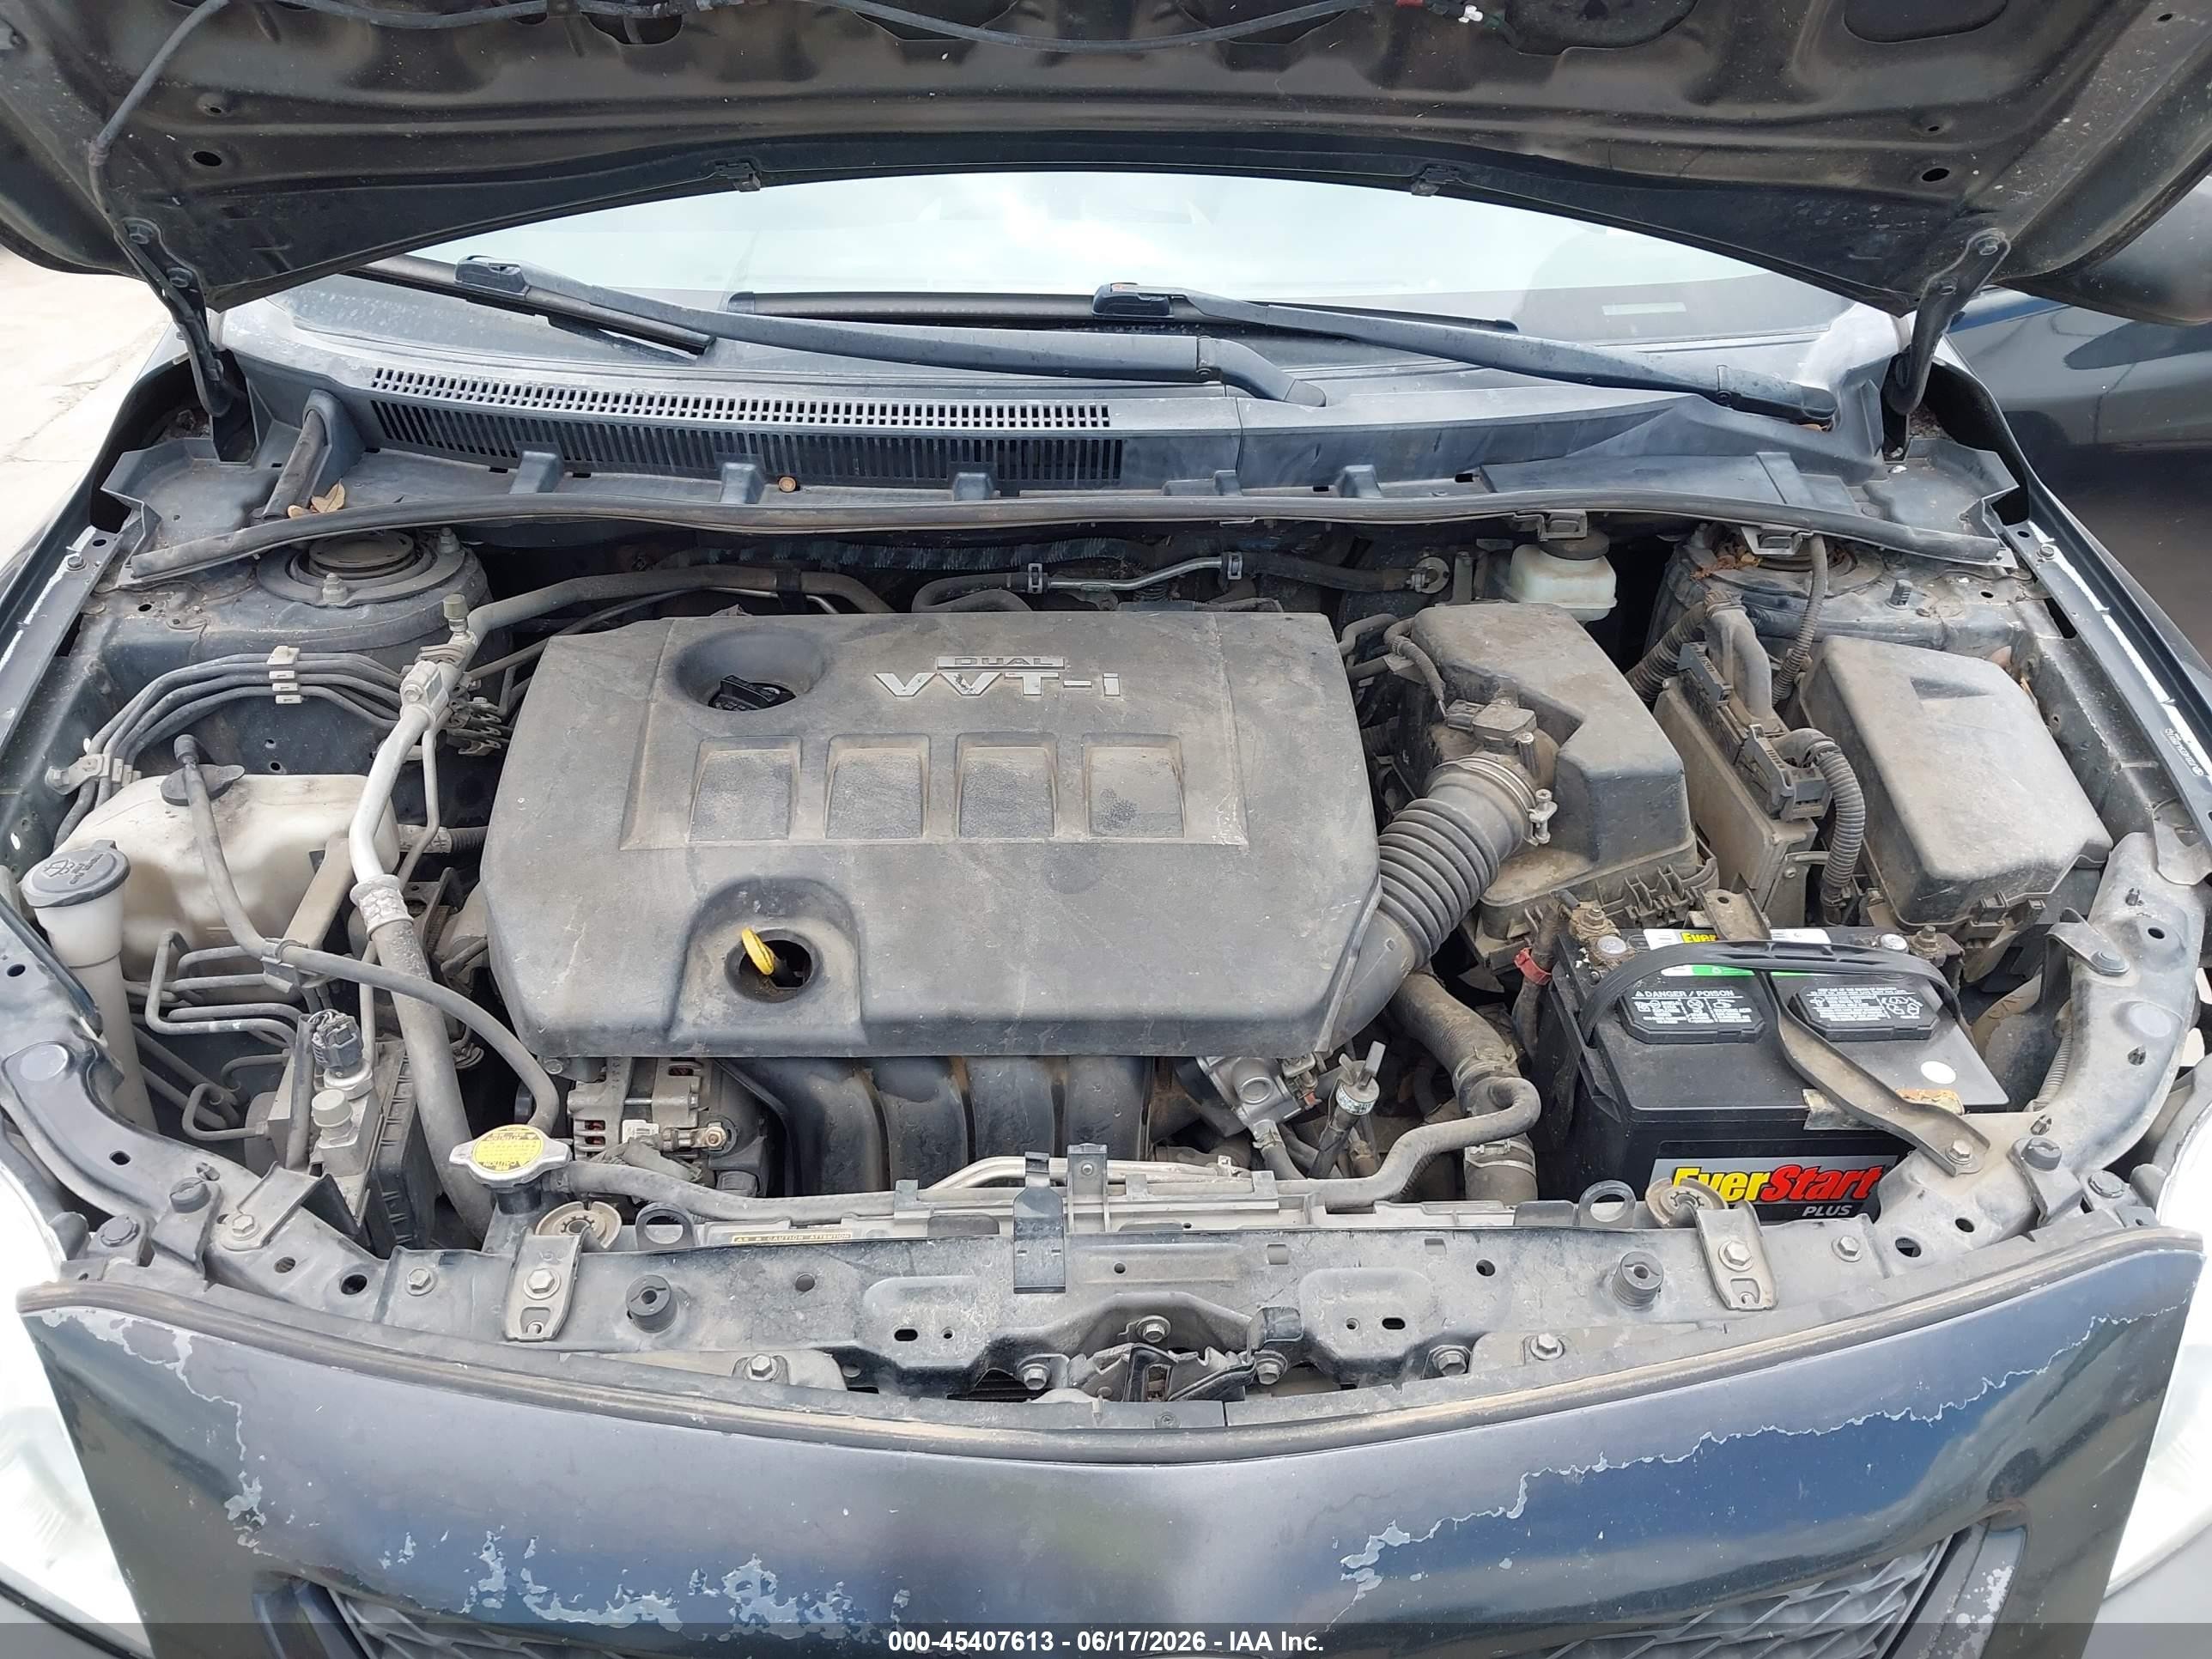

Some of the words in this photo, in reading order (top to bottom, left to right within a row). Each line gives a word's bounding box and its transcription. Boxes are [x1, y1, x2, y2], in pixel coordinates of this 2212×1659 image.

[955, 658, 1053, 666] DUAL
[873, 672, 1121, 698] VVT-i
[1802, 1204, 1853, 1217] PLUS
